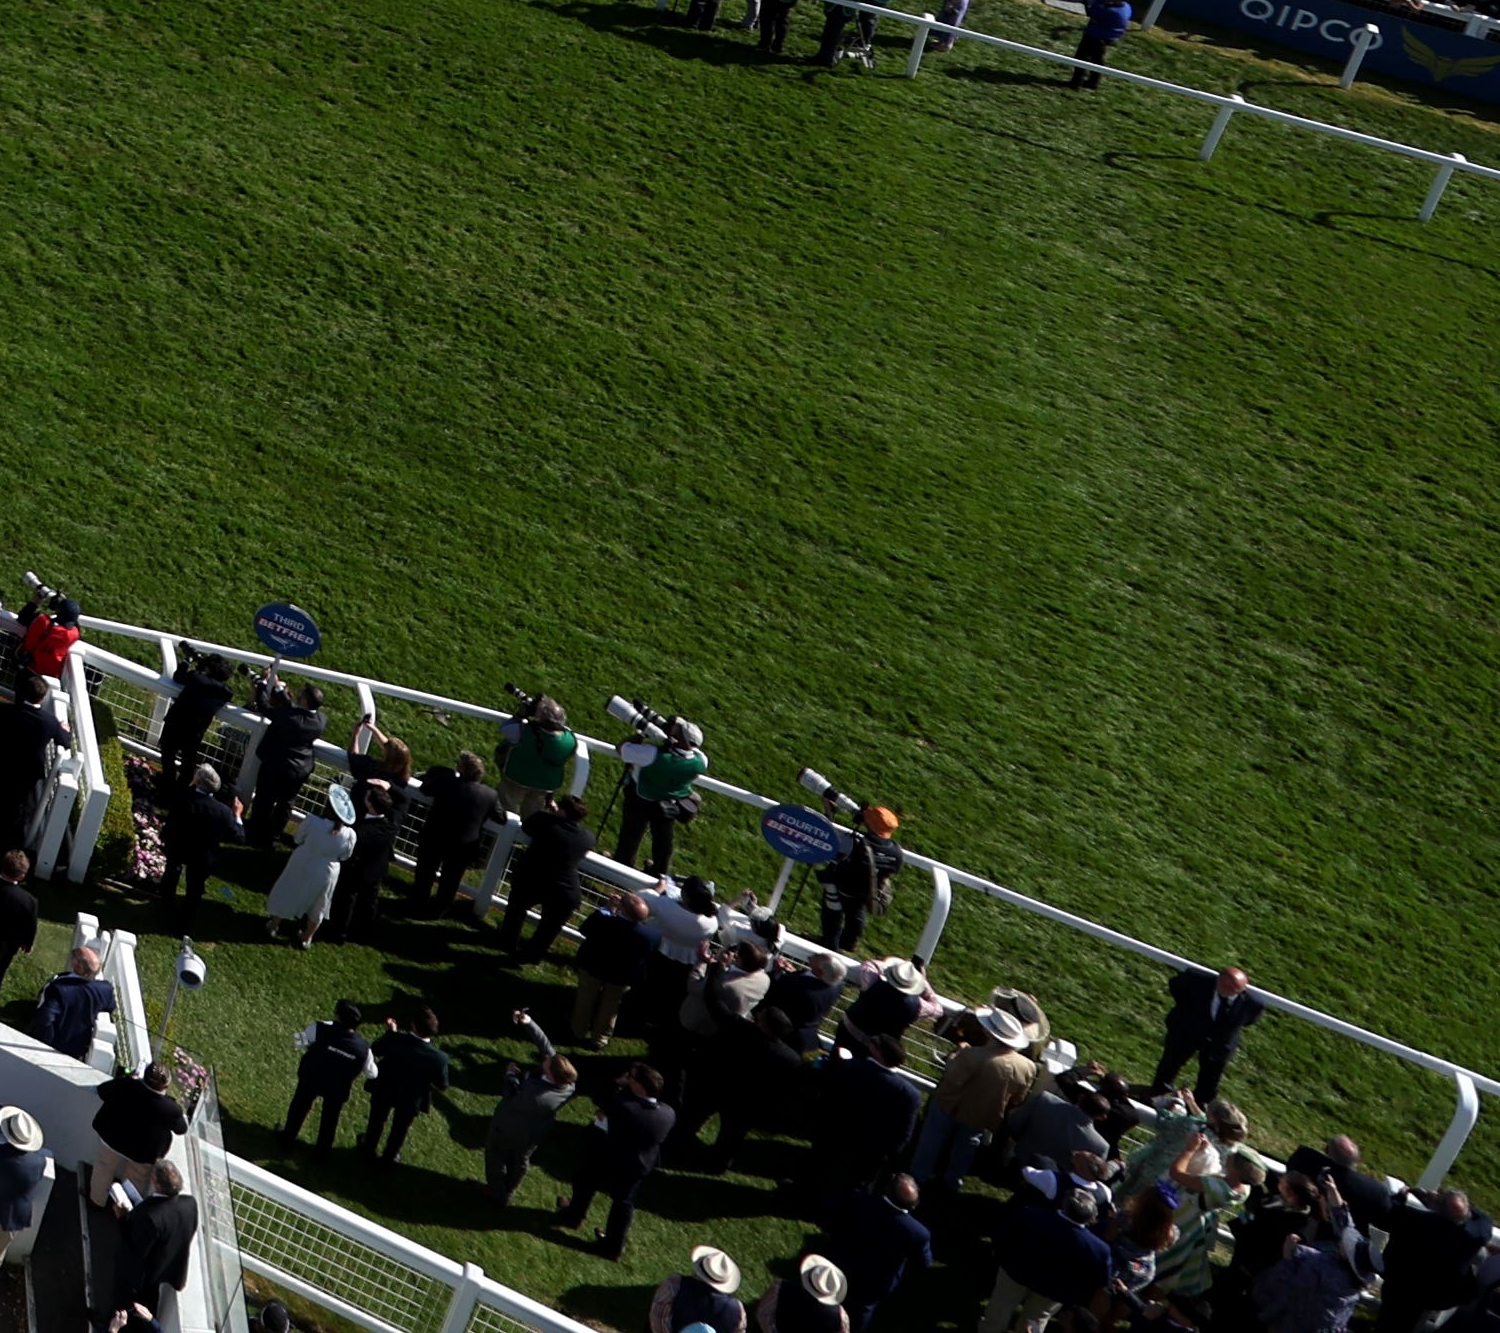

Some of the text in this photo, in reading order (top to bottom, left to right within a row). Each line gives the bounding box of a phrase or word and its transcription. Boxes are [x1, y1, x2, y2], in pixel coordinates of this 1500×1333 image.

[258, 617, 314, 645] BETFRED
[274, 612, 305, 631] THIRD
[766, 819, 833, 851] BETFRED
[778, 813, 830, 840] FOURTH
